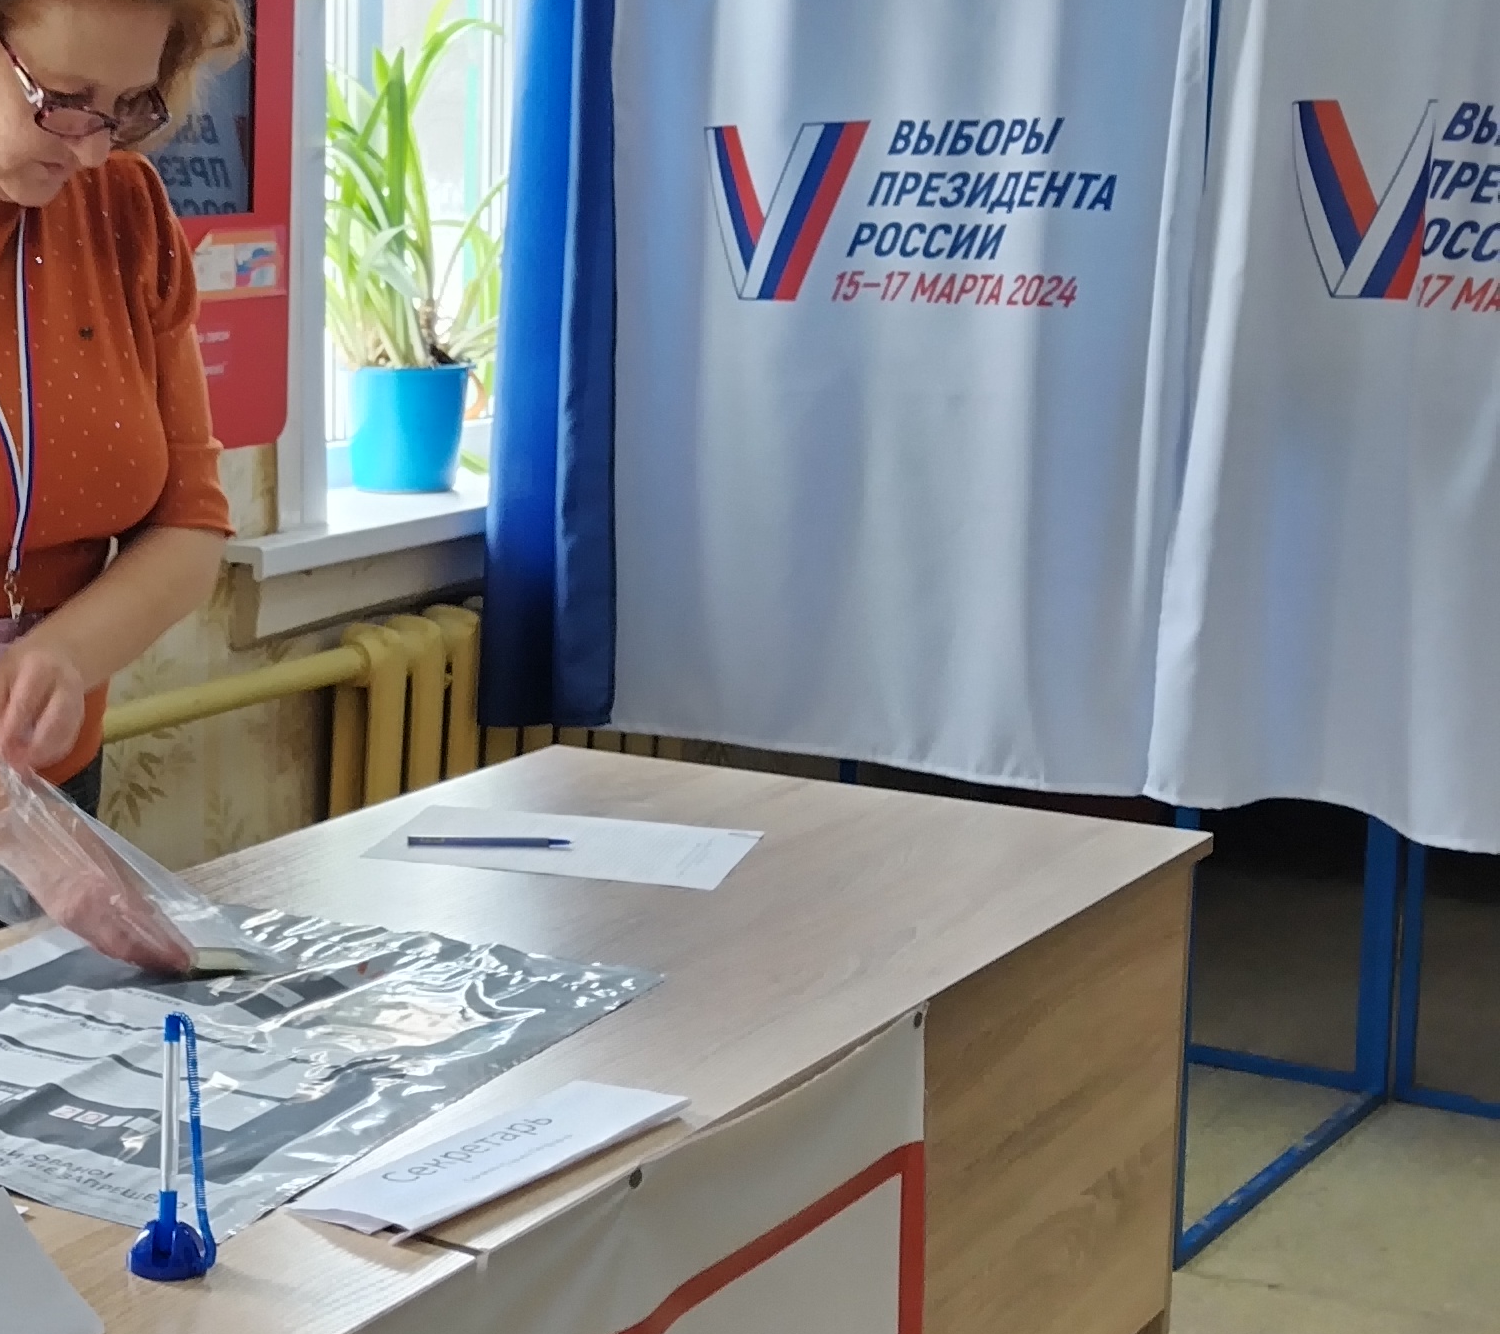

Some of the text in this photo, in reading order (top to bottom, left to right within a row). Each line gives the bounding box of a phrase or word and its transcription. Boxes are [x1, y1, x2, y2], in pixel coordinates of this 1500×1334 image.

[887, 117, 1065, 156] ВЫБОРЫ
[867, 171, 1117, 214] ПРЕЗИДЕНТА
[846, 222, 1007, 260] РОССИИ
[910, 272, 1004, 305] МАРТА
[1006, 274, 1078, 308] 2024
[381, 1116, 553, 1183] Секретарь
